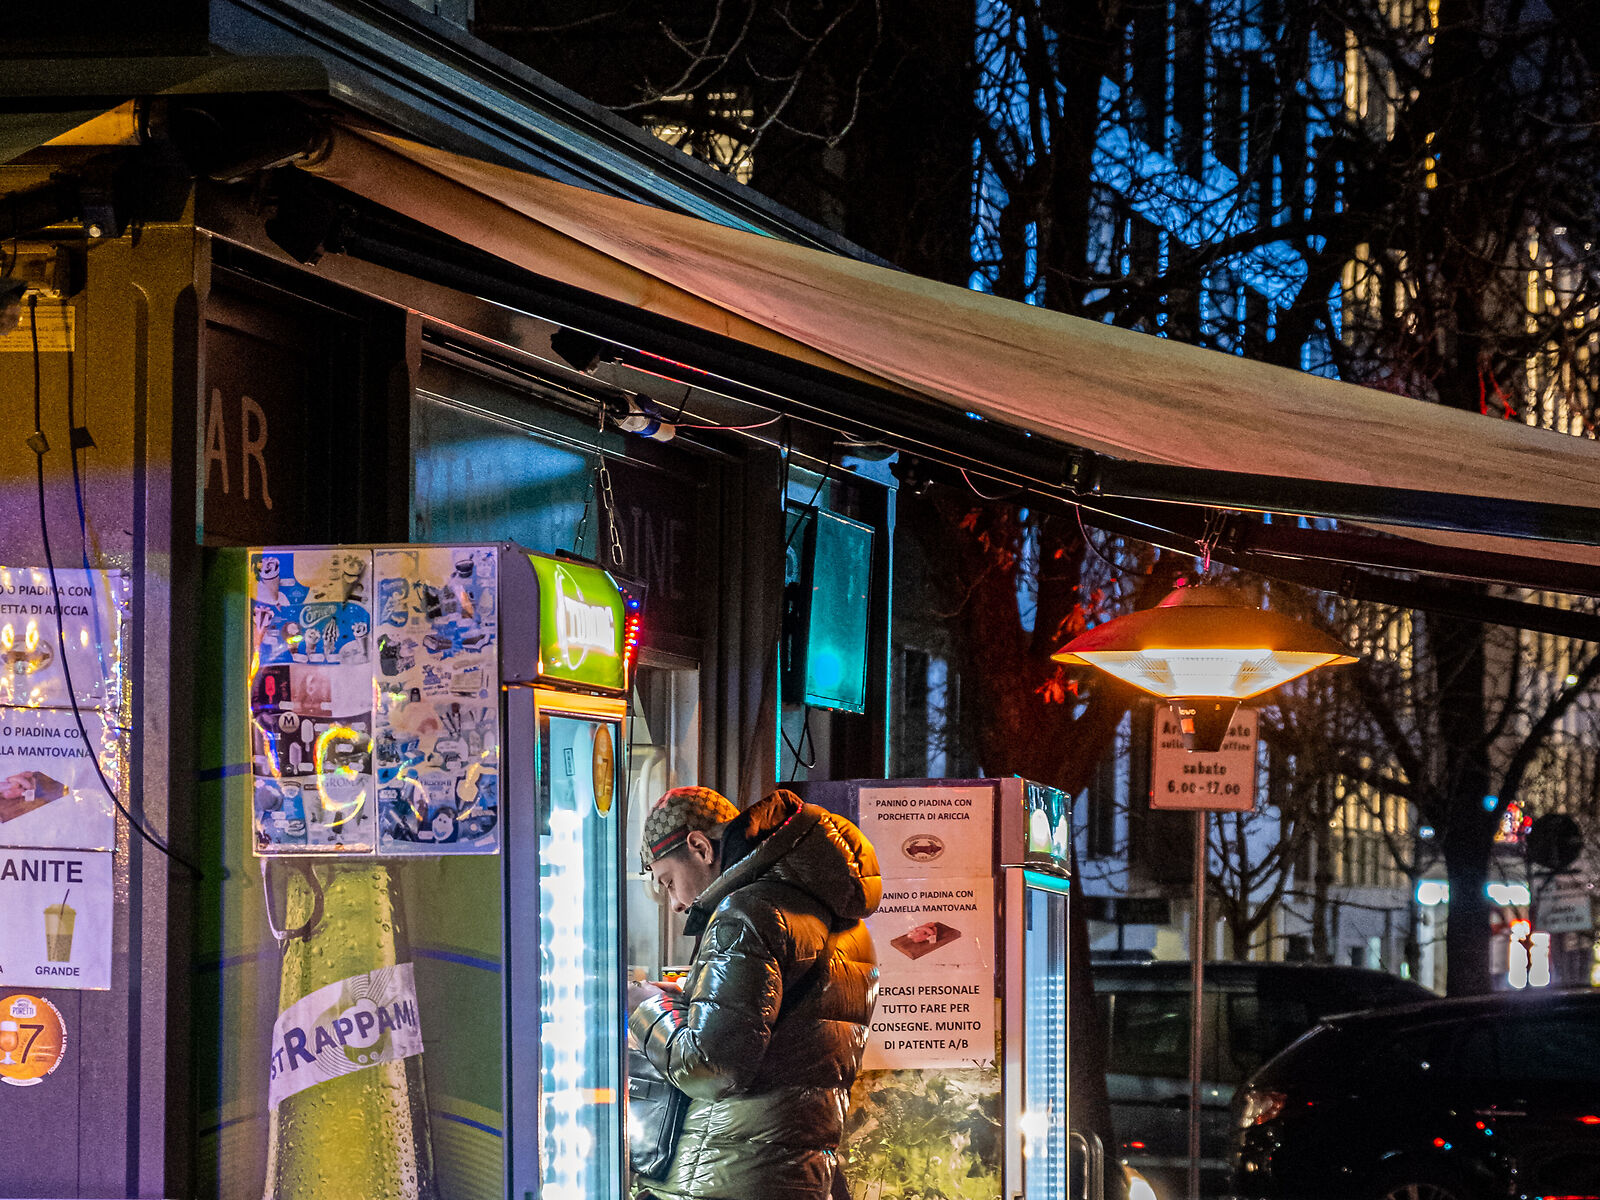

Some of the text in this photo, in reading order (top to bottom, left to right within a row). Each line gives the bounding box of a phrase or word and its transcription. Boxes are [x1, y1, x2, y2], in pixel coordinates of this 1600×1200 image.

[19, 586, 65, 596] PIADIA
[68, 586, 92, 596] CON
[31, 605, 42, 614] DI
[3, 726, 12, 736] O
[15, 727, 61, 737] PIADINA
[1183, 761, 1227, 775] sabato
[876, 798, 972, 807] PANINO O PIADINA CON
[878, 812, 970, 820] PORCHETTA DI ARICCIA
[882, 890, 974, 899] ANINO O PIADINA CON
[922, 903, 978, 912] MANTOVANA
[35, 965, 80, 976] GRANDE
[878, 985, 980, 996] ERCASI PERSONALE
[882, 1003, 970, 1013] TUTTO FARE PER
[871, 1021, 981, 1032] CONSEGNE. MUNITO
[20, 1024, 45, 1064] 7
[271, 1000, 416, 1081] STRAPPAMI
[884, 1039, 969, 1050] DI PATENTE A/B
